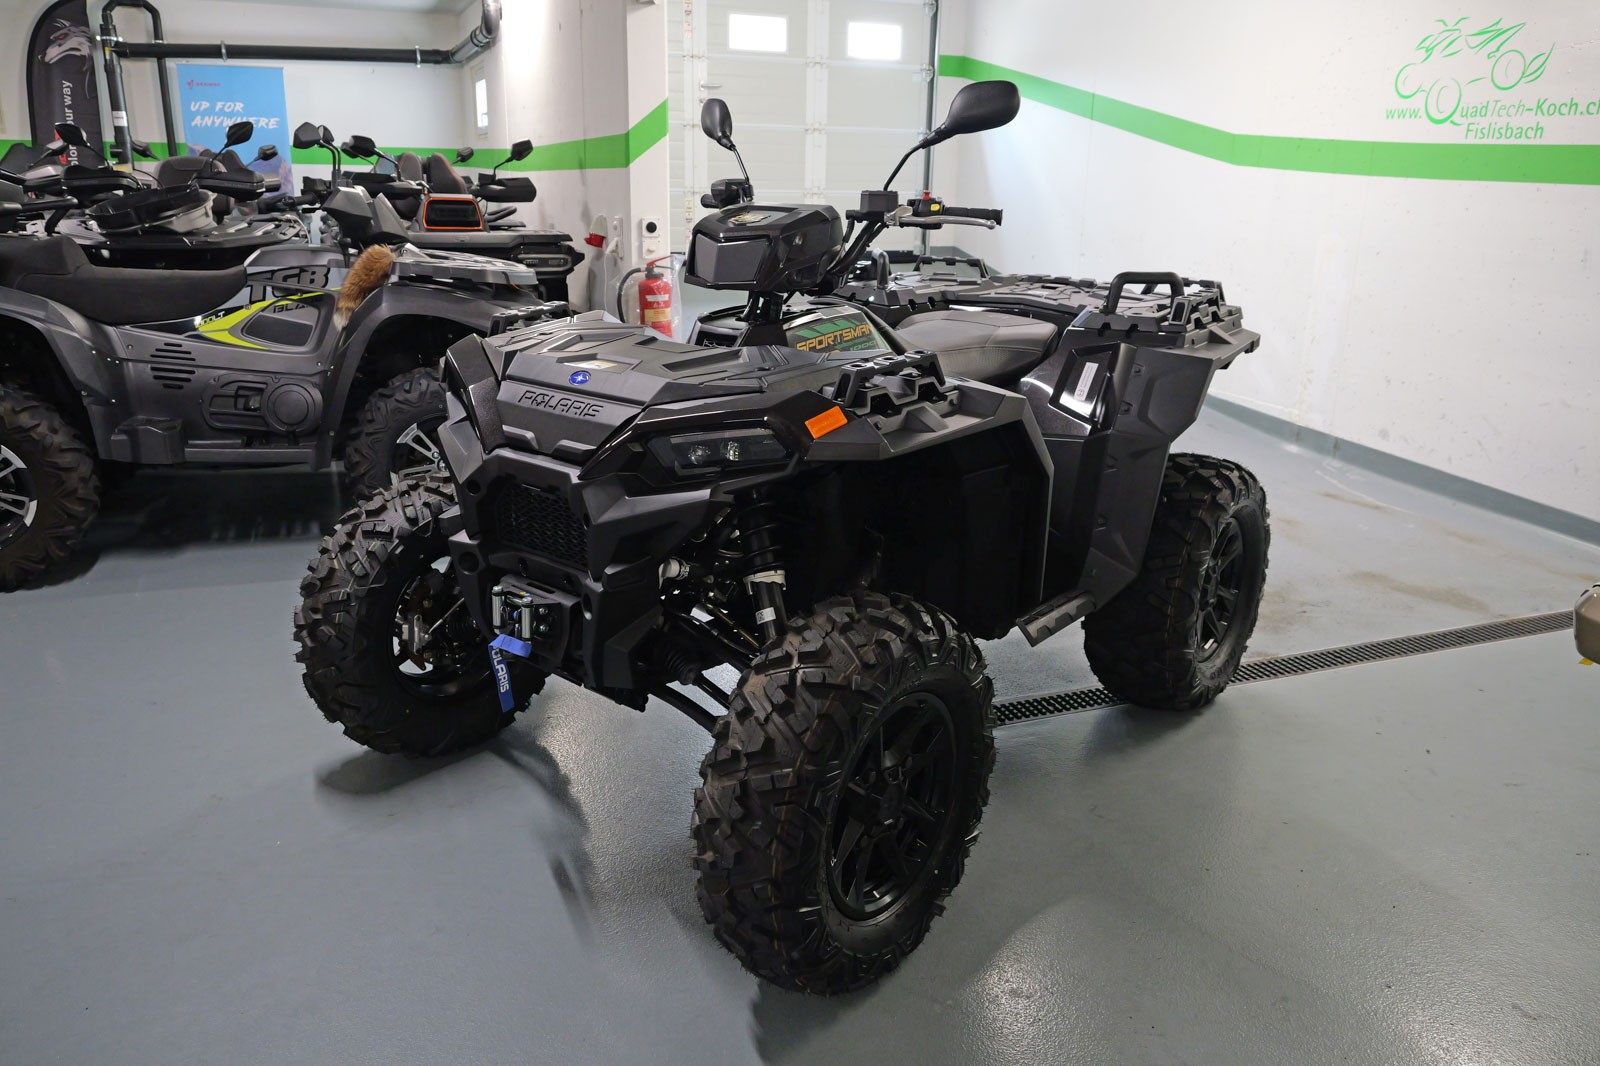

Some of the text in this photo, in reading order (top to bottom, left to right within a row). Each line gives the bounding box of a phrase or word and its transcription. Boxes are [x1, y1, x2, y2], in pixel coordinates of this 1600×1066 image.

[62, 80, 73, 106] way
[190, 101, 244, 113] UP FOR
[1464, 121, 1544, 140] Fislisbach
[246, 264, 330, 304] TGB
[517, 389, 604, 418] POLARIS
[492, 648, 510, 693] OLARIS
